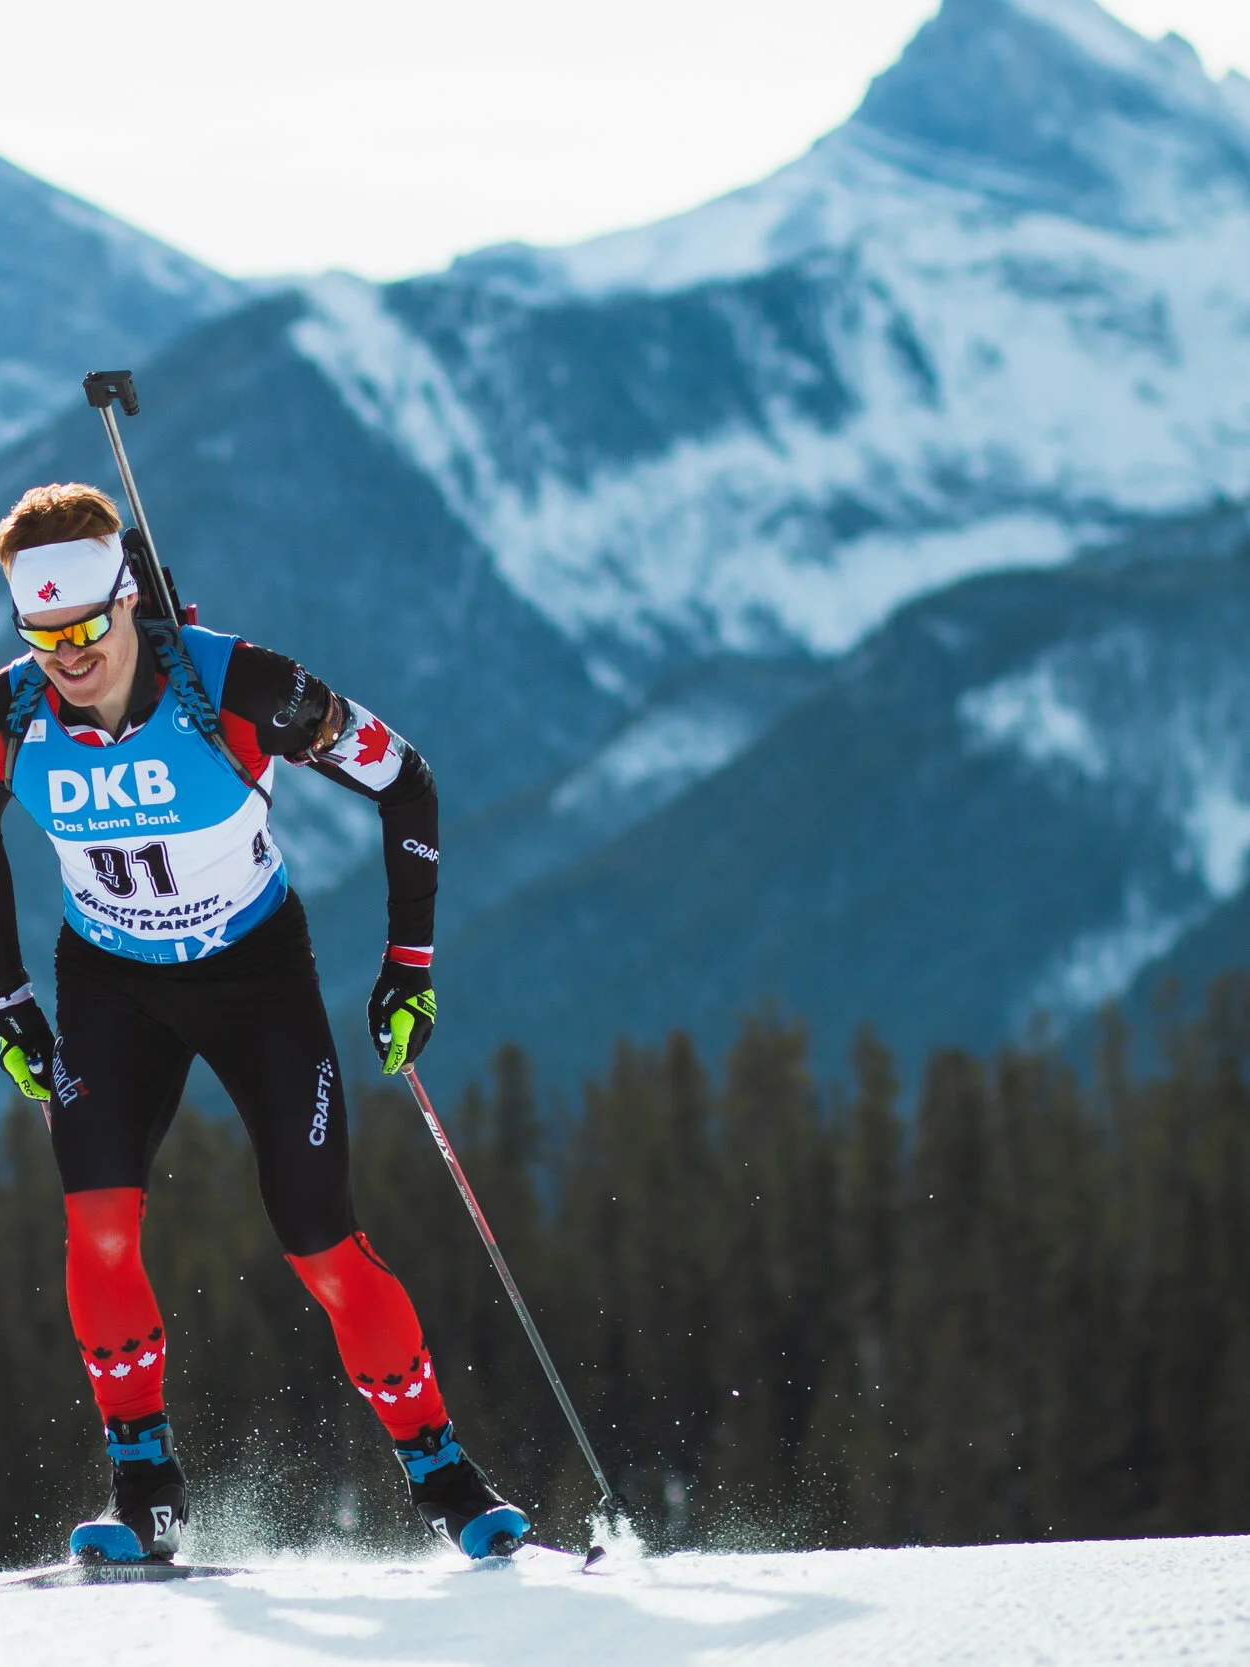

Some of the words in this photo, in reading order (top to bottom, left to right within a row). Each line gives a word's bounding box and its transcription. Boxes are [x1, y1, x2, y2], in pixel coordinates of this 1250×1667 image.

[271, 667, 306, 729] Canada
[48, 759, 176, 813] DKB
[53, 819, 84, 833] Das
[88, 817, 131, 831] kann
[135, 810, 181, 827] Bank
[83, 840, 180, 899] 91
[401, 838, 441, 865] CRAF
[309, 1074, 331, 1146] CRAFT
